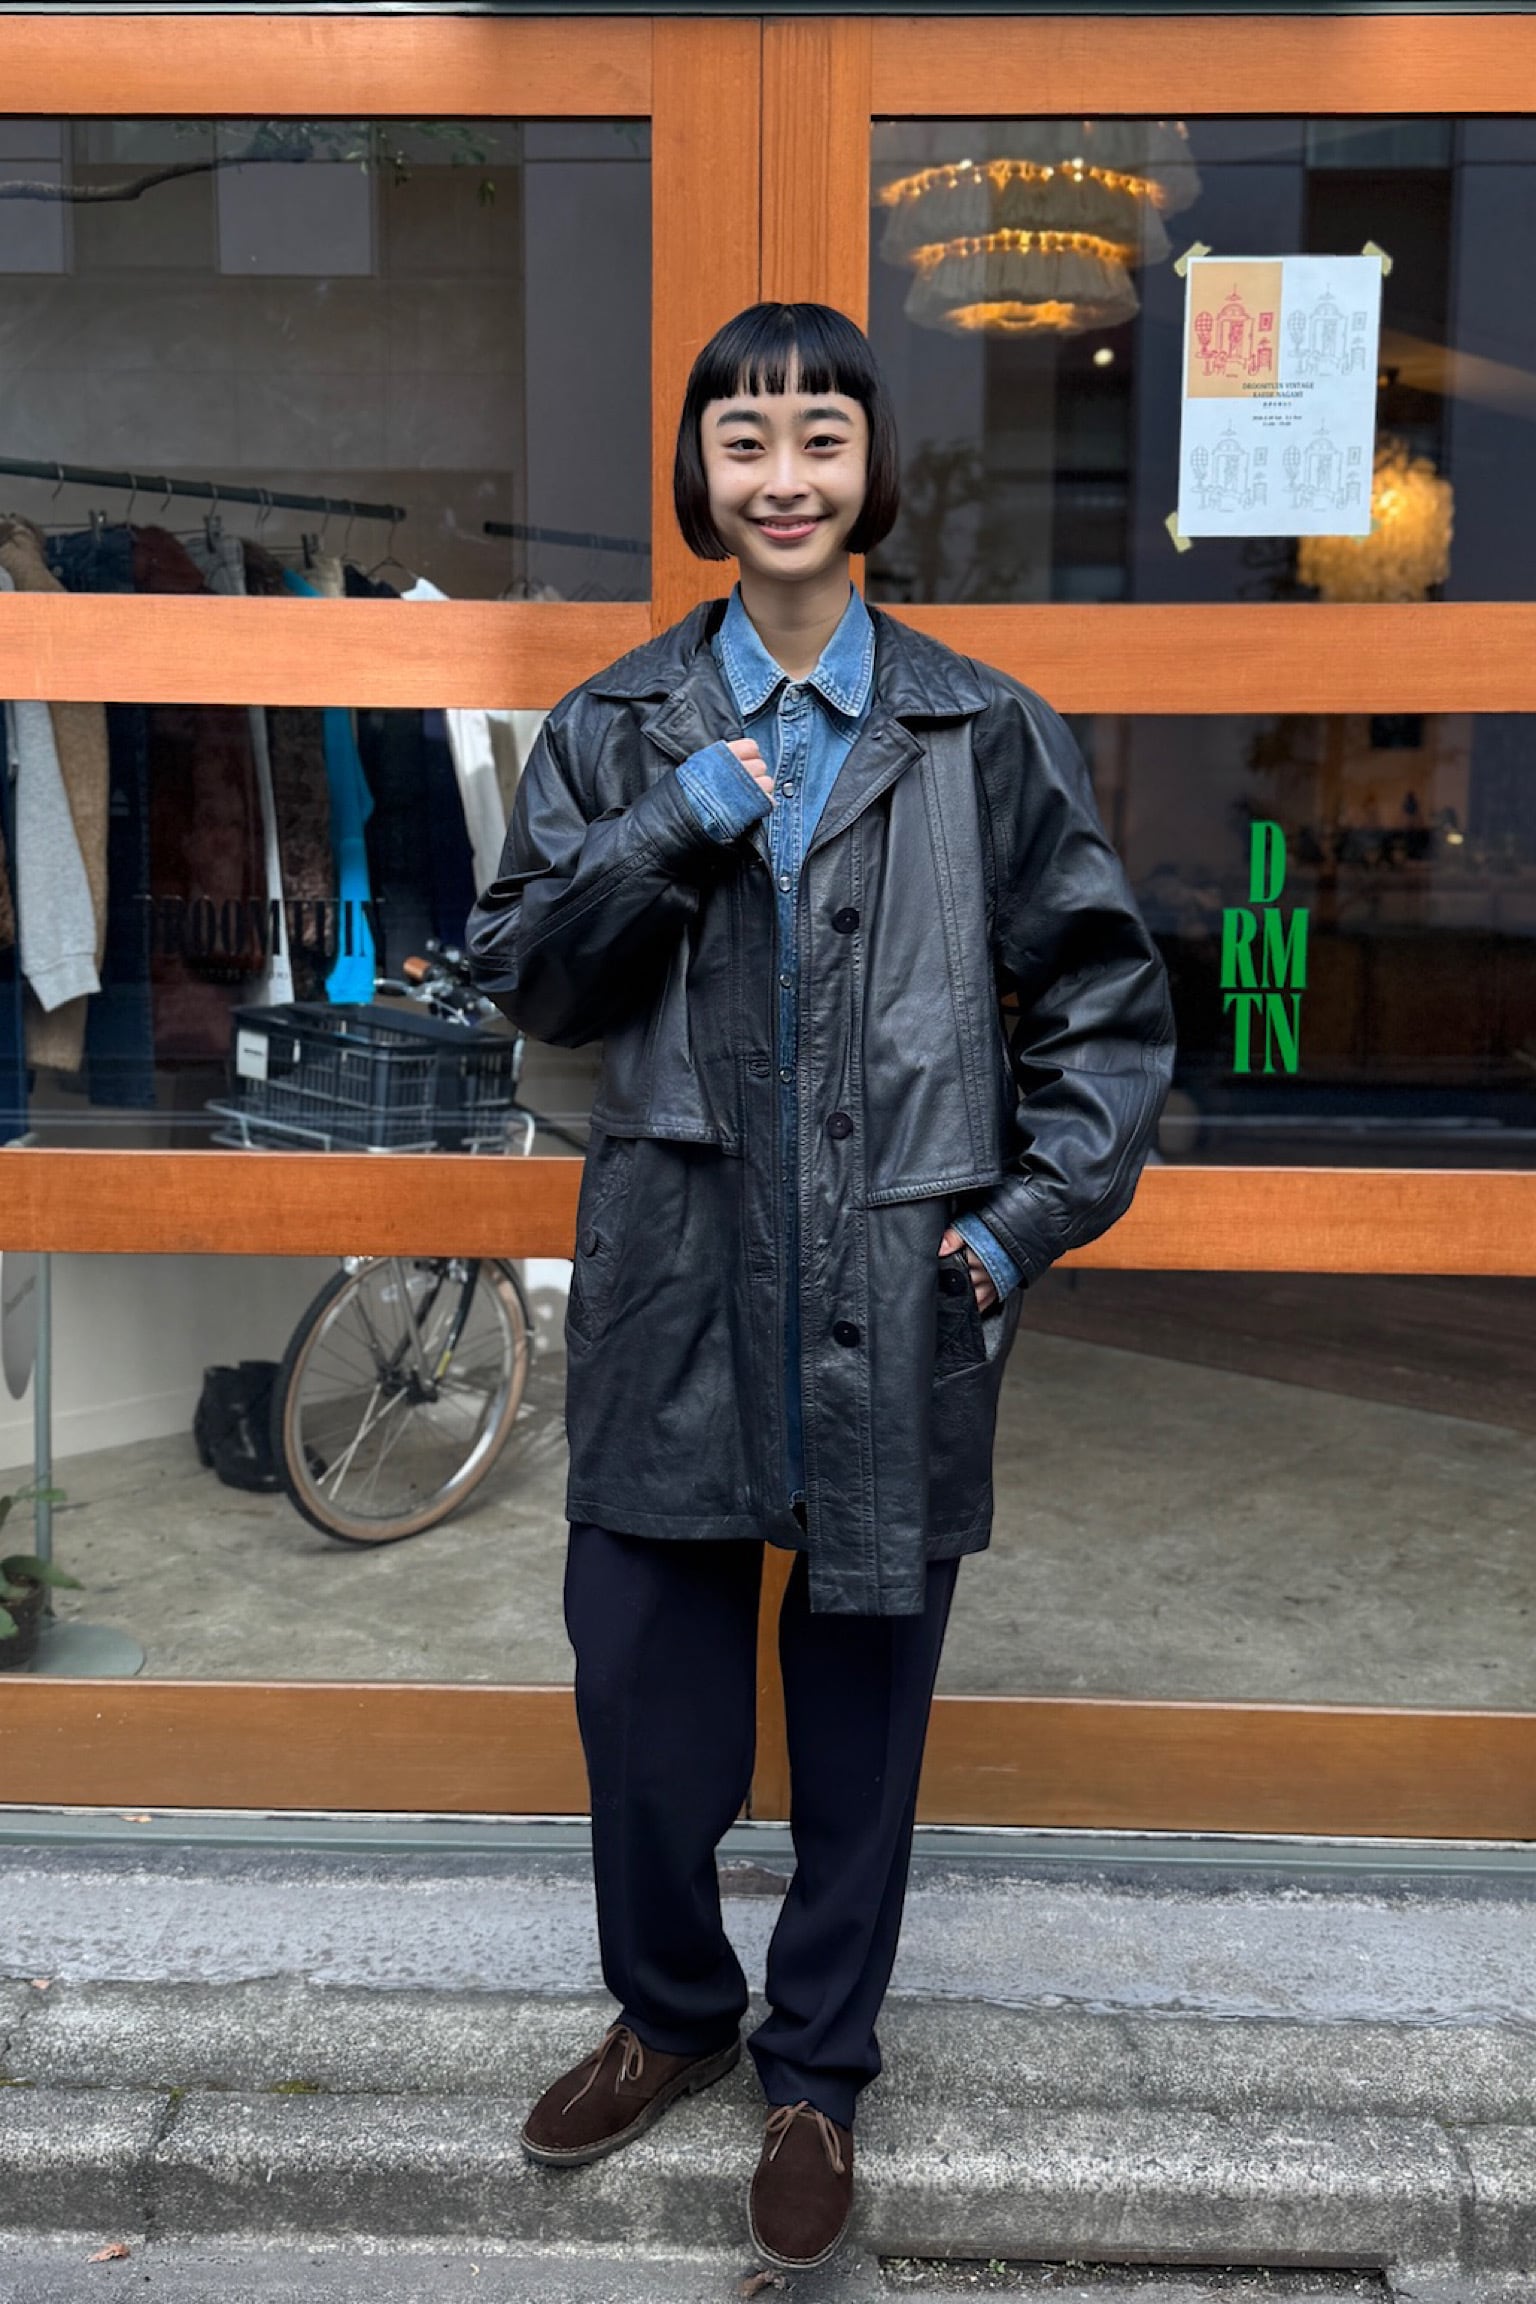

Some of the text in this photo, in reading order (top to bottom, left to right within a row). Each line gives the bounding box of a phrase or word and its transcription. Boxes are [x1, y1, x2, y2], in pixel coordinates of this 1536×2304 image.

[1249, 821, 1287, 903] D
[1220, 907, 1310, 989] RM
[1223, 993, 1302, 1074] TN
